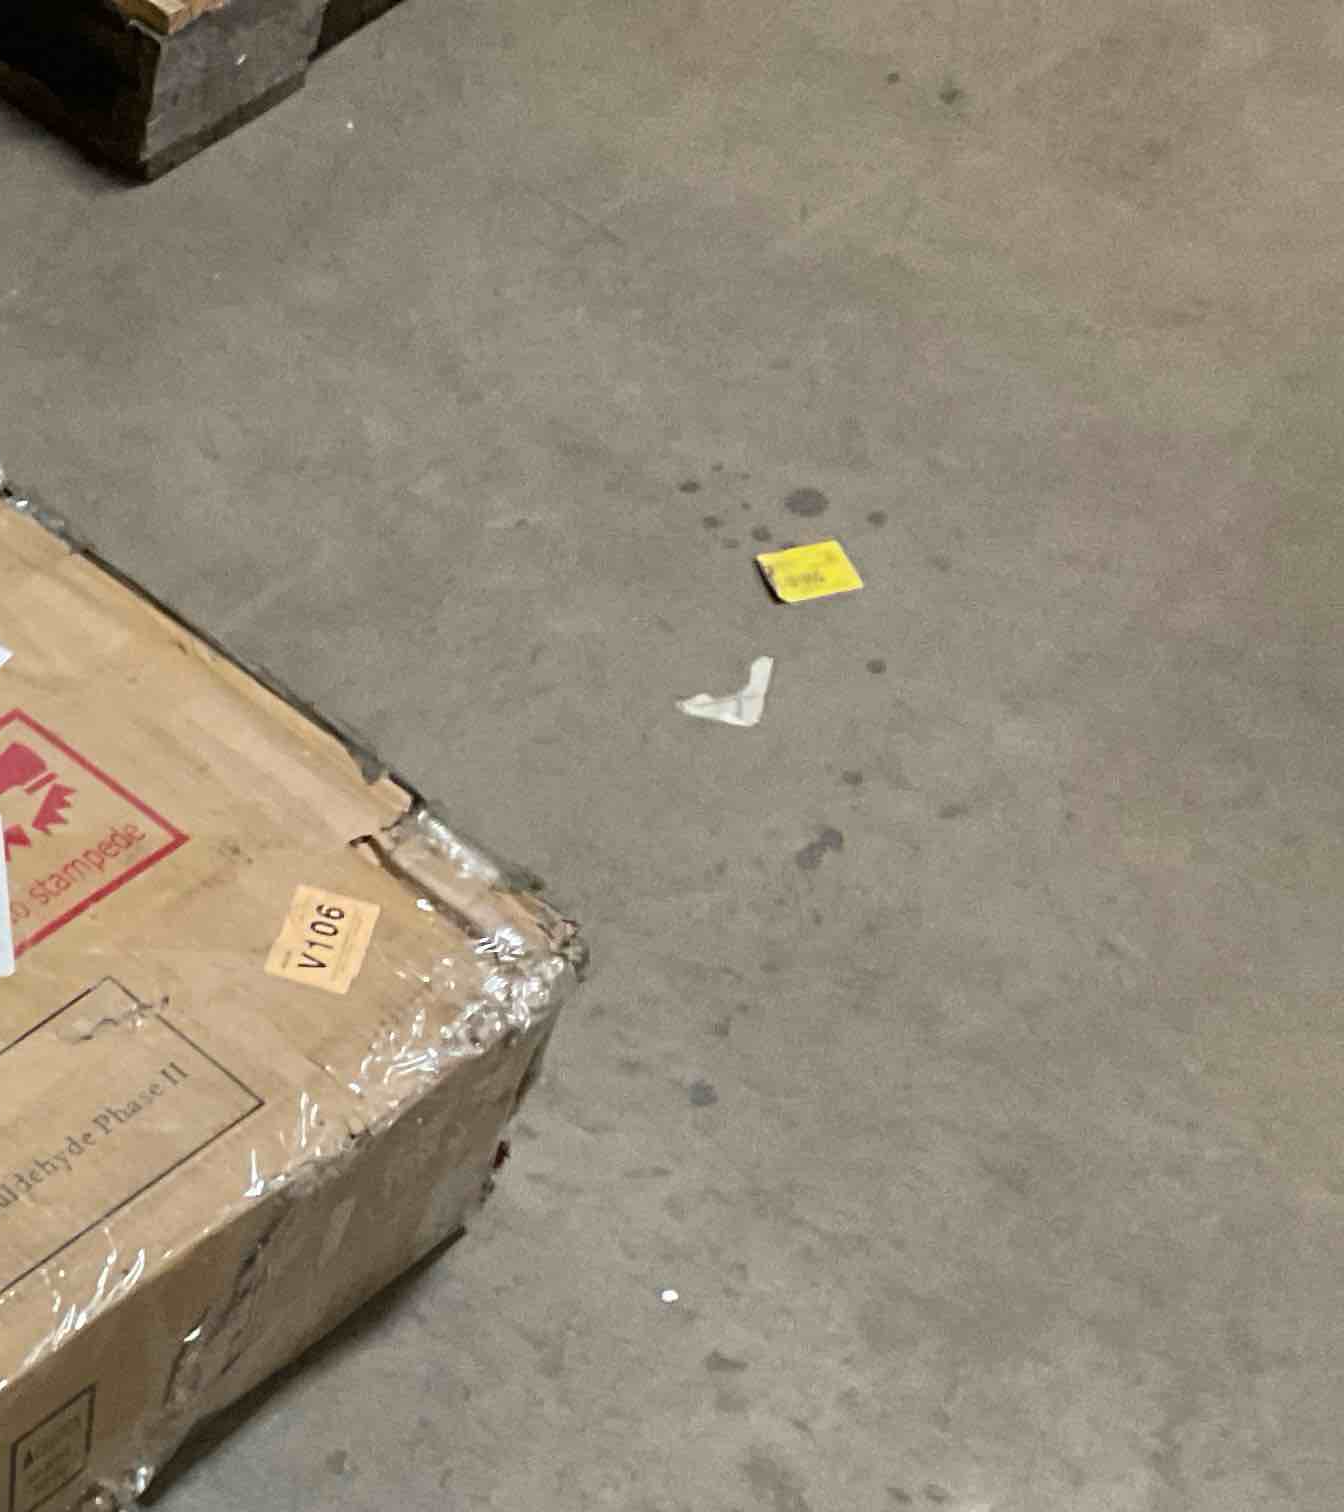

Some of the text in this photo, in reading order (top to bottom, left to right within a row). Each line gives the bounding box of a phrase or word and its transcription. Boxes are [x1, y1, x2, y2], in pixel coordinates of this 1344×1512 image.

[29, 818, 147, 905] stampede
[296, 902, 347, 973] V106
[90, 1090, 162, 1137] Phase
[160, 1061, 190, 1089] II
